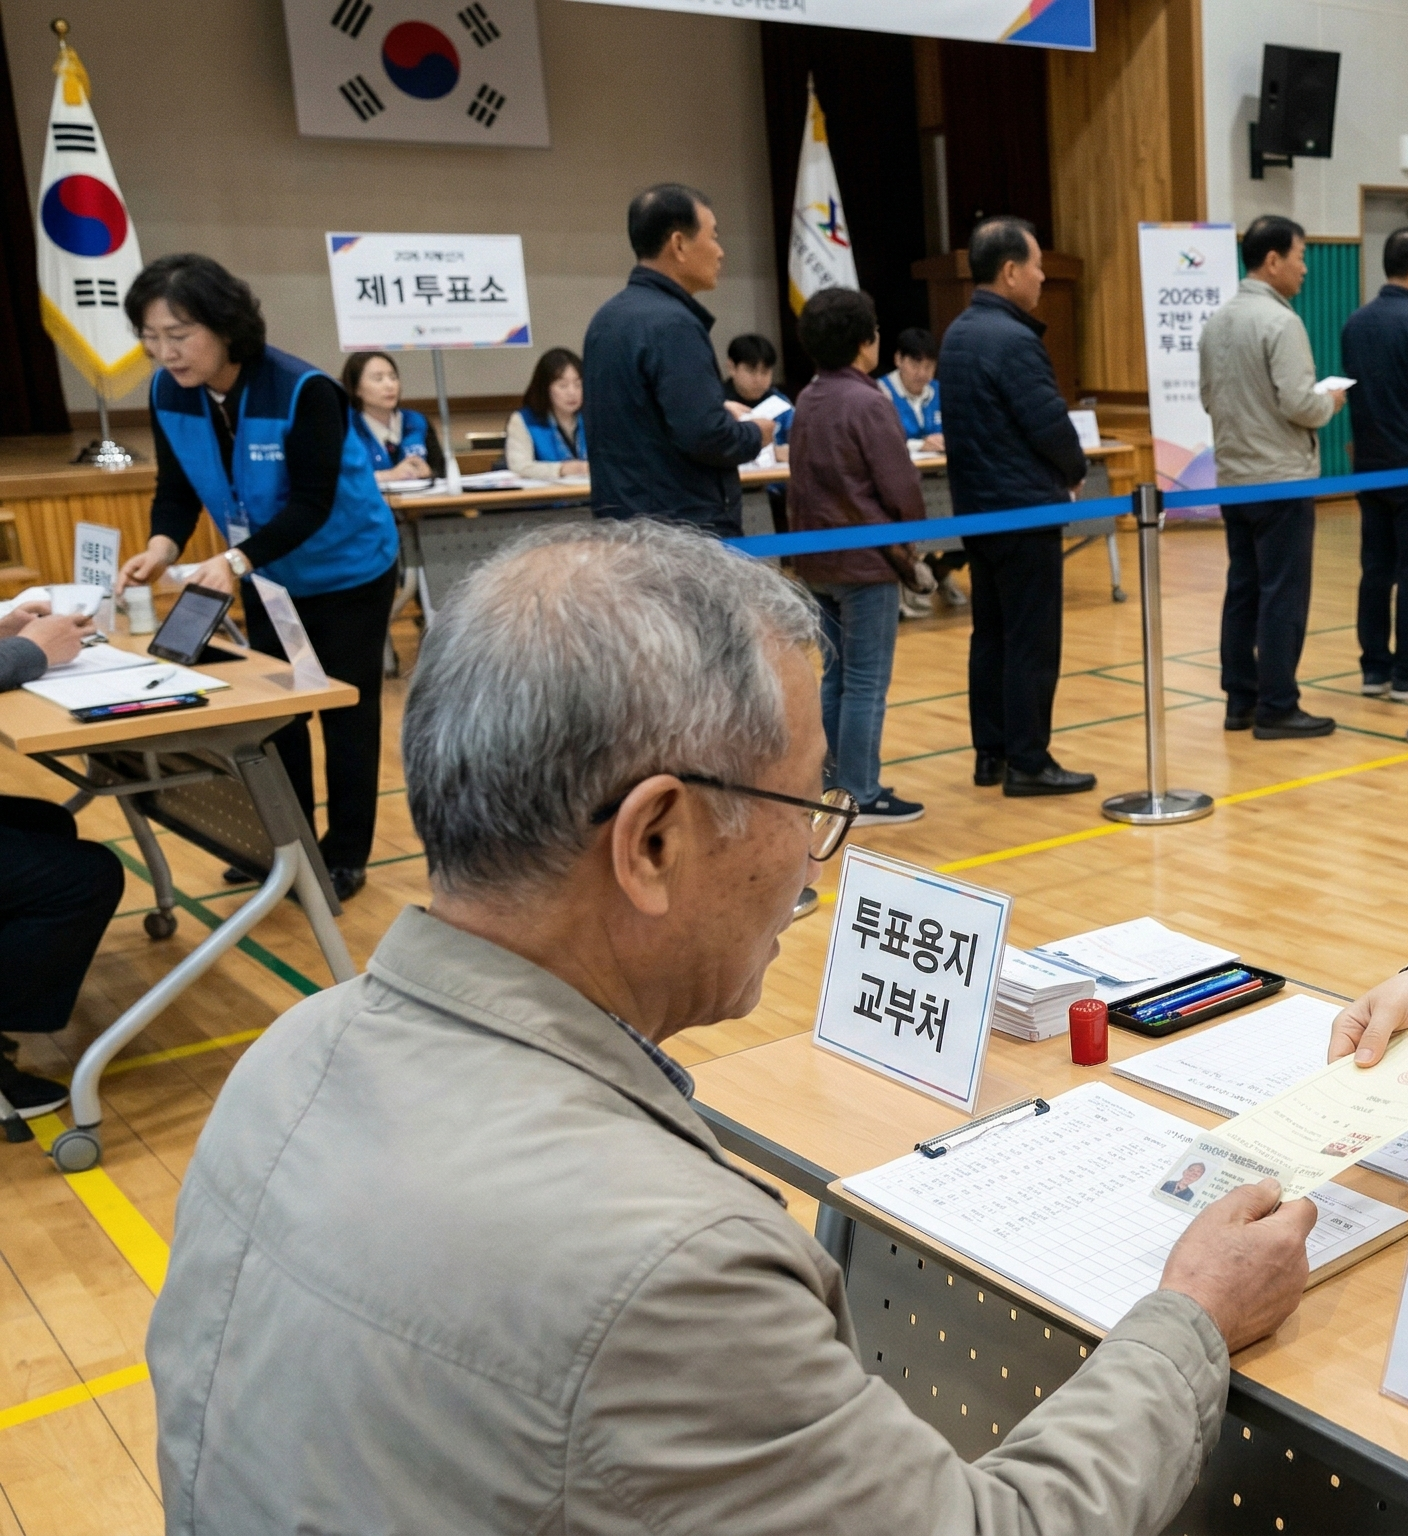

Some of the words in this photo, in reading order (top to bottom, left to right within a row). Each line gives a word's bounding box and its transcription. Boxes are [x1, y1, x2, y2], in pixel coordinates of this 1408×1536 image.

[1159, 334, 1199, 354] 투표
[851, 896, 979, 988] 투표용지
[853, 972, 950, 1053] 교부처
